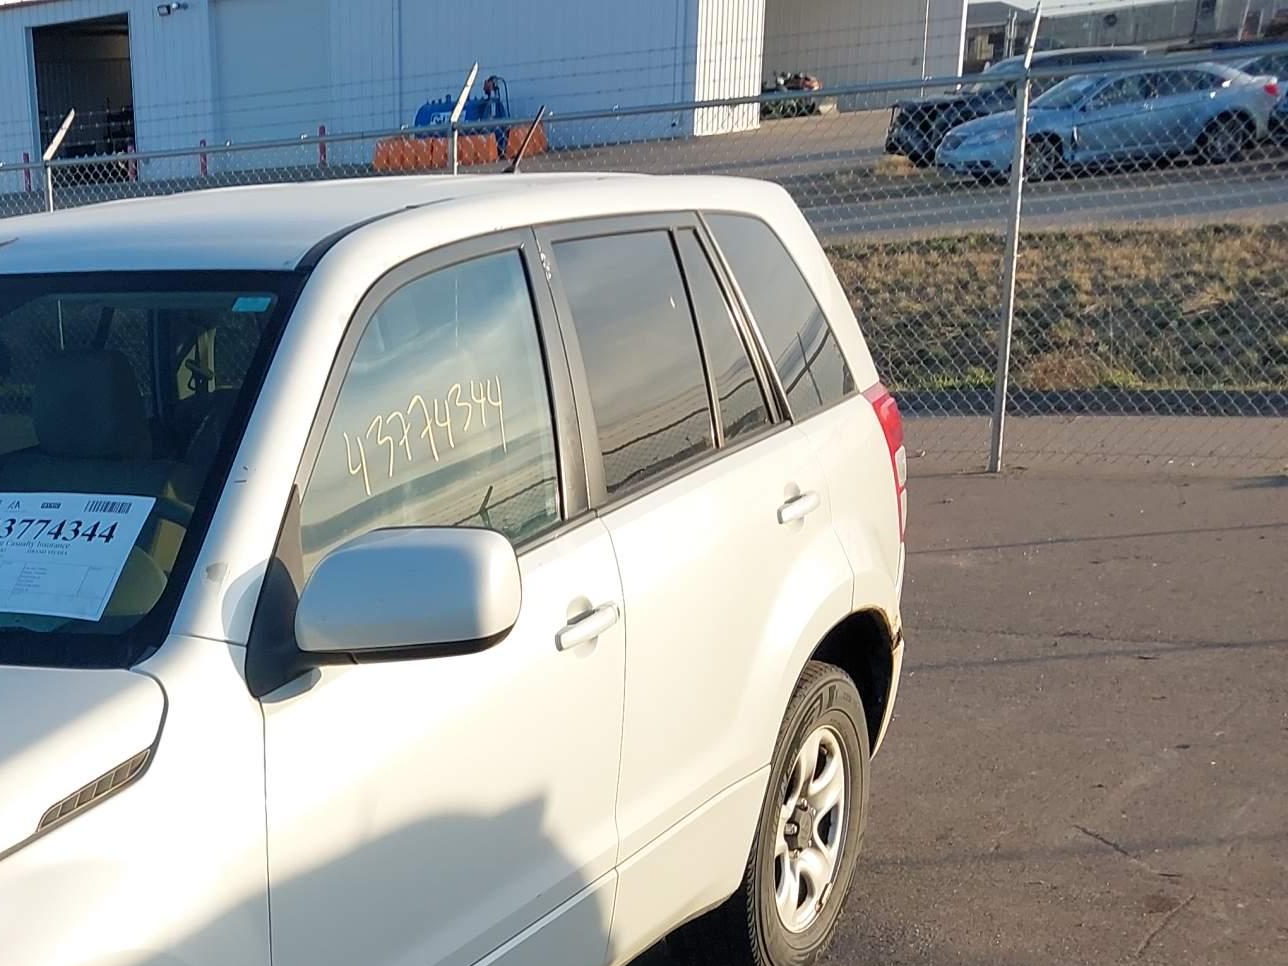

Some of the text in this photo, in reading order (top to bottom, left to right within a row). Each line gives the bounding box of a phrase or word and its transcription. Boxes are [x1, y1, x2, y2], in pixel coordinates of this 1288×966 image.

[343, 375, 508, 497] 43774344
[5, 539, 34, 549] Casualty
[36, 540, 71, 550] Insurance
